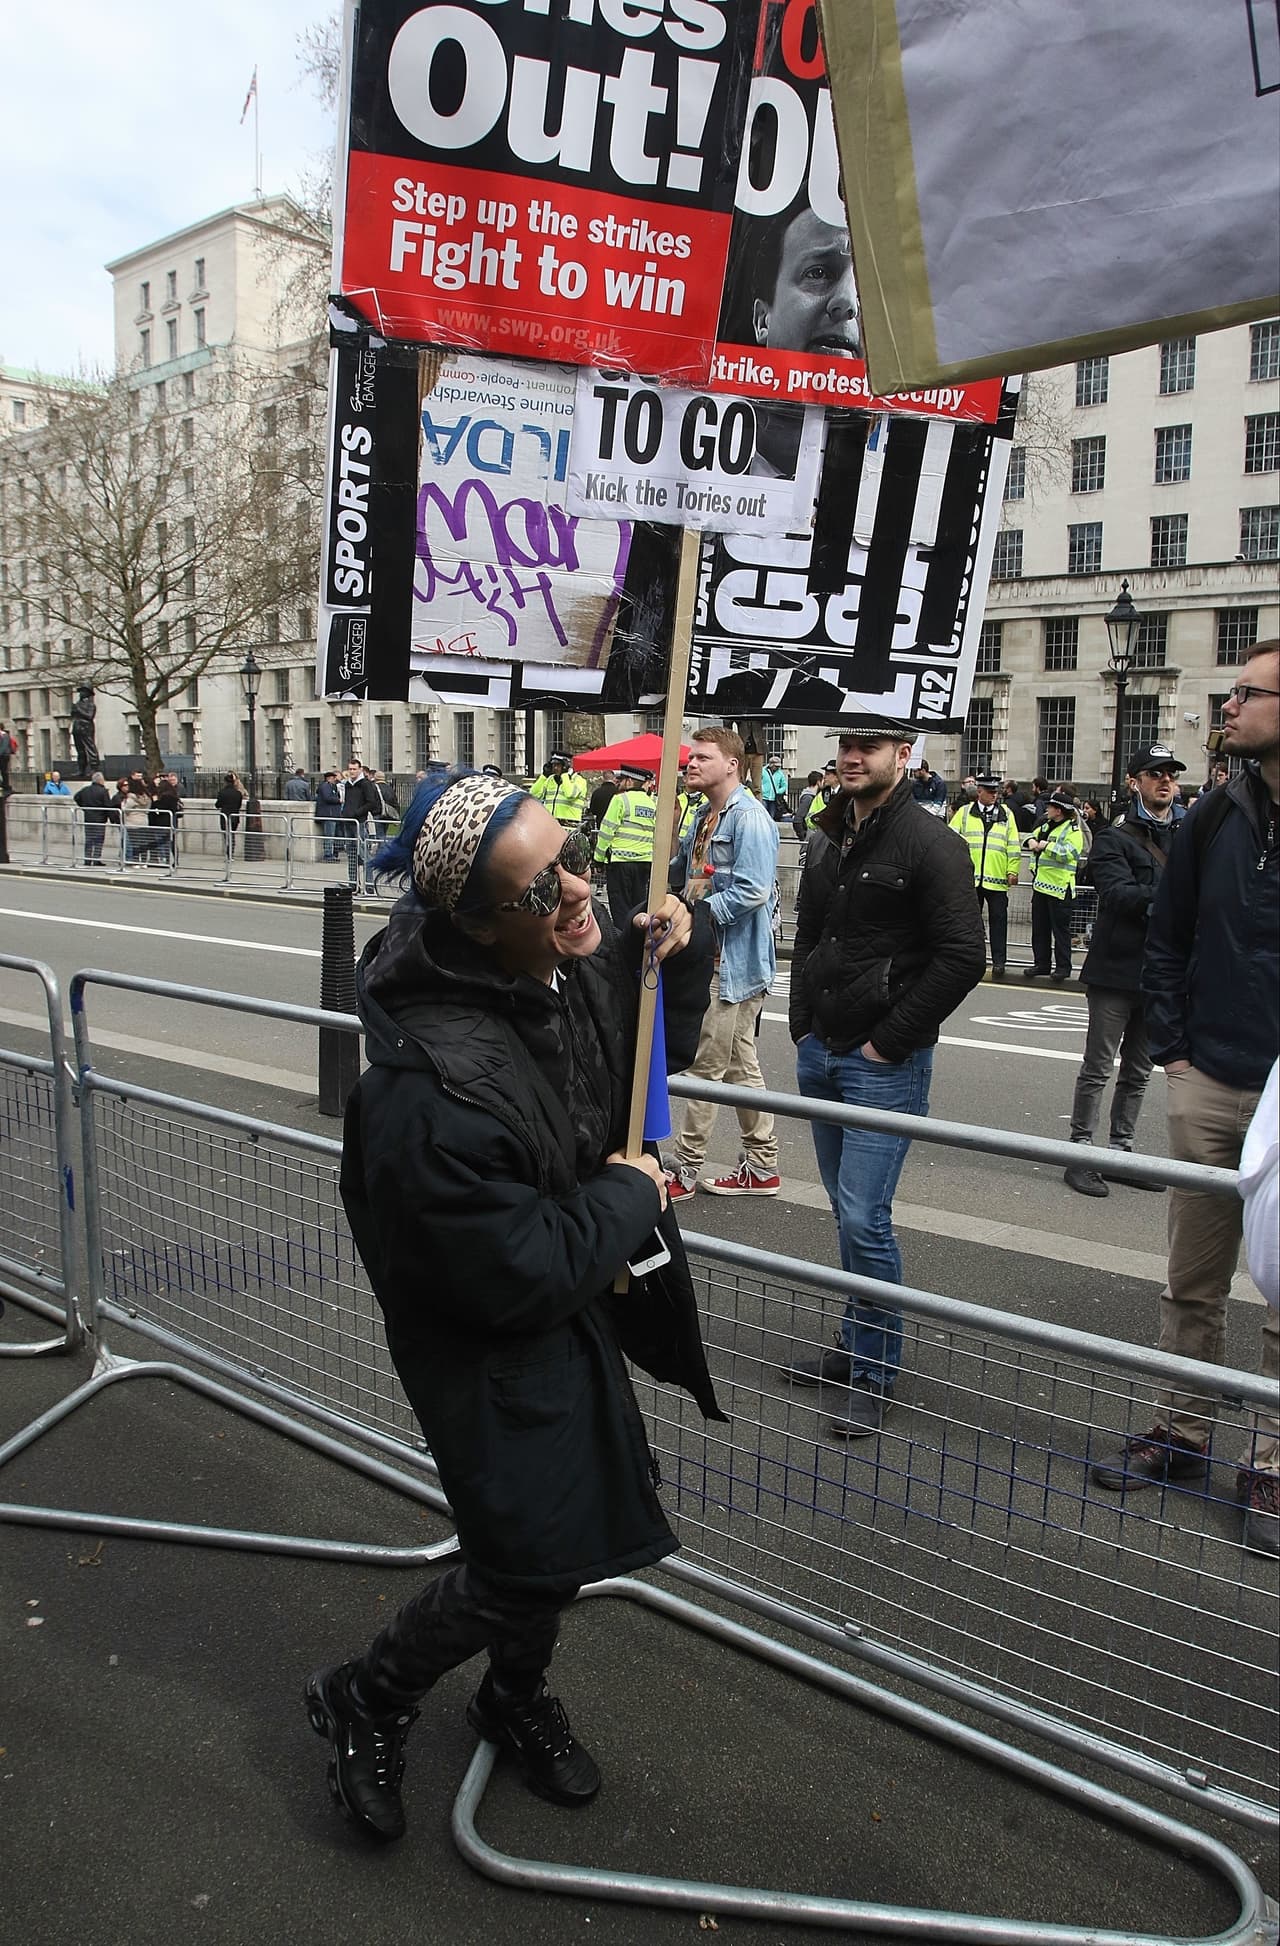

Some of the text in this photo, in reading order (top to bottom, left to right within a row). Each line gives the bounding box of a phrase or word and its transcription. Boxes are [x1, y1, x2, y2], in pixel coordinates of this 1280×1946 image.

[388, 5, 720, 192] Out!
[391, 177, 692, 258] Step up the strikes
[389, 219, 686, 316] Fight to win
[437, 307, 622, 351] www.swp.org.uk
[362, 351, 376, 401] BANGER
[594, 386, 755, 475] TO GO
[334, 424, 372, 597] SPORTS
[586, 473, 767, 517] Kick the Tories out
[351, 623, 363, 669] BANGER
